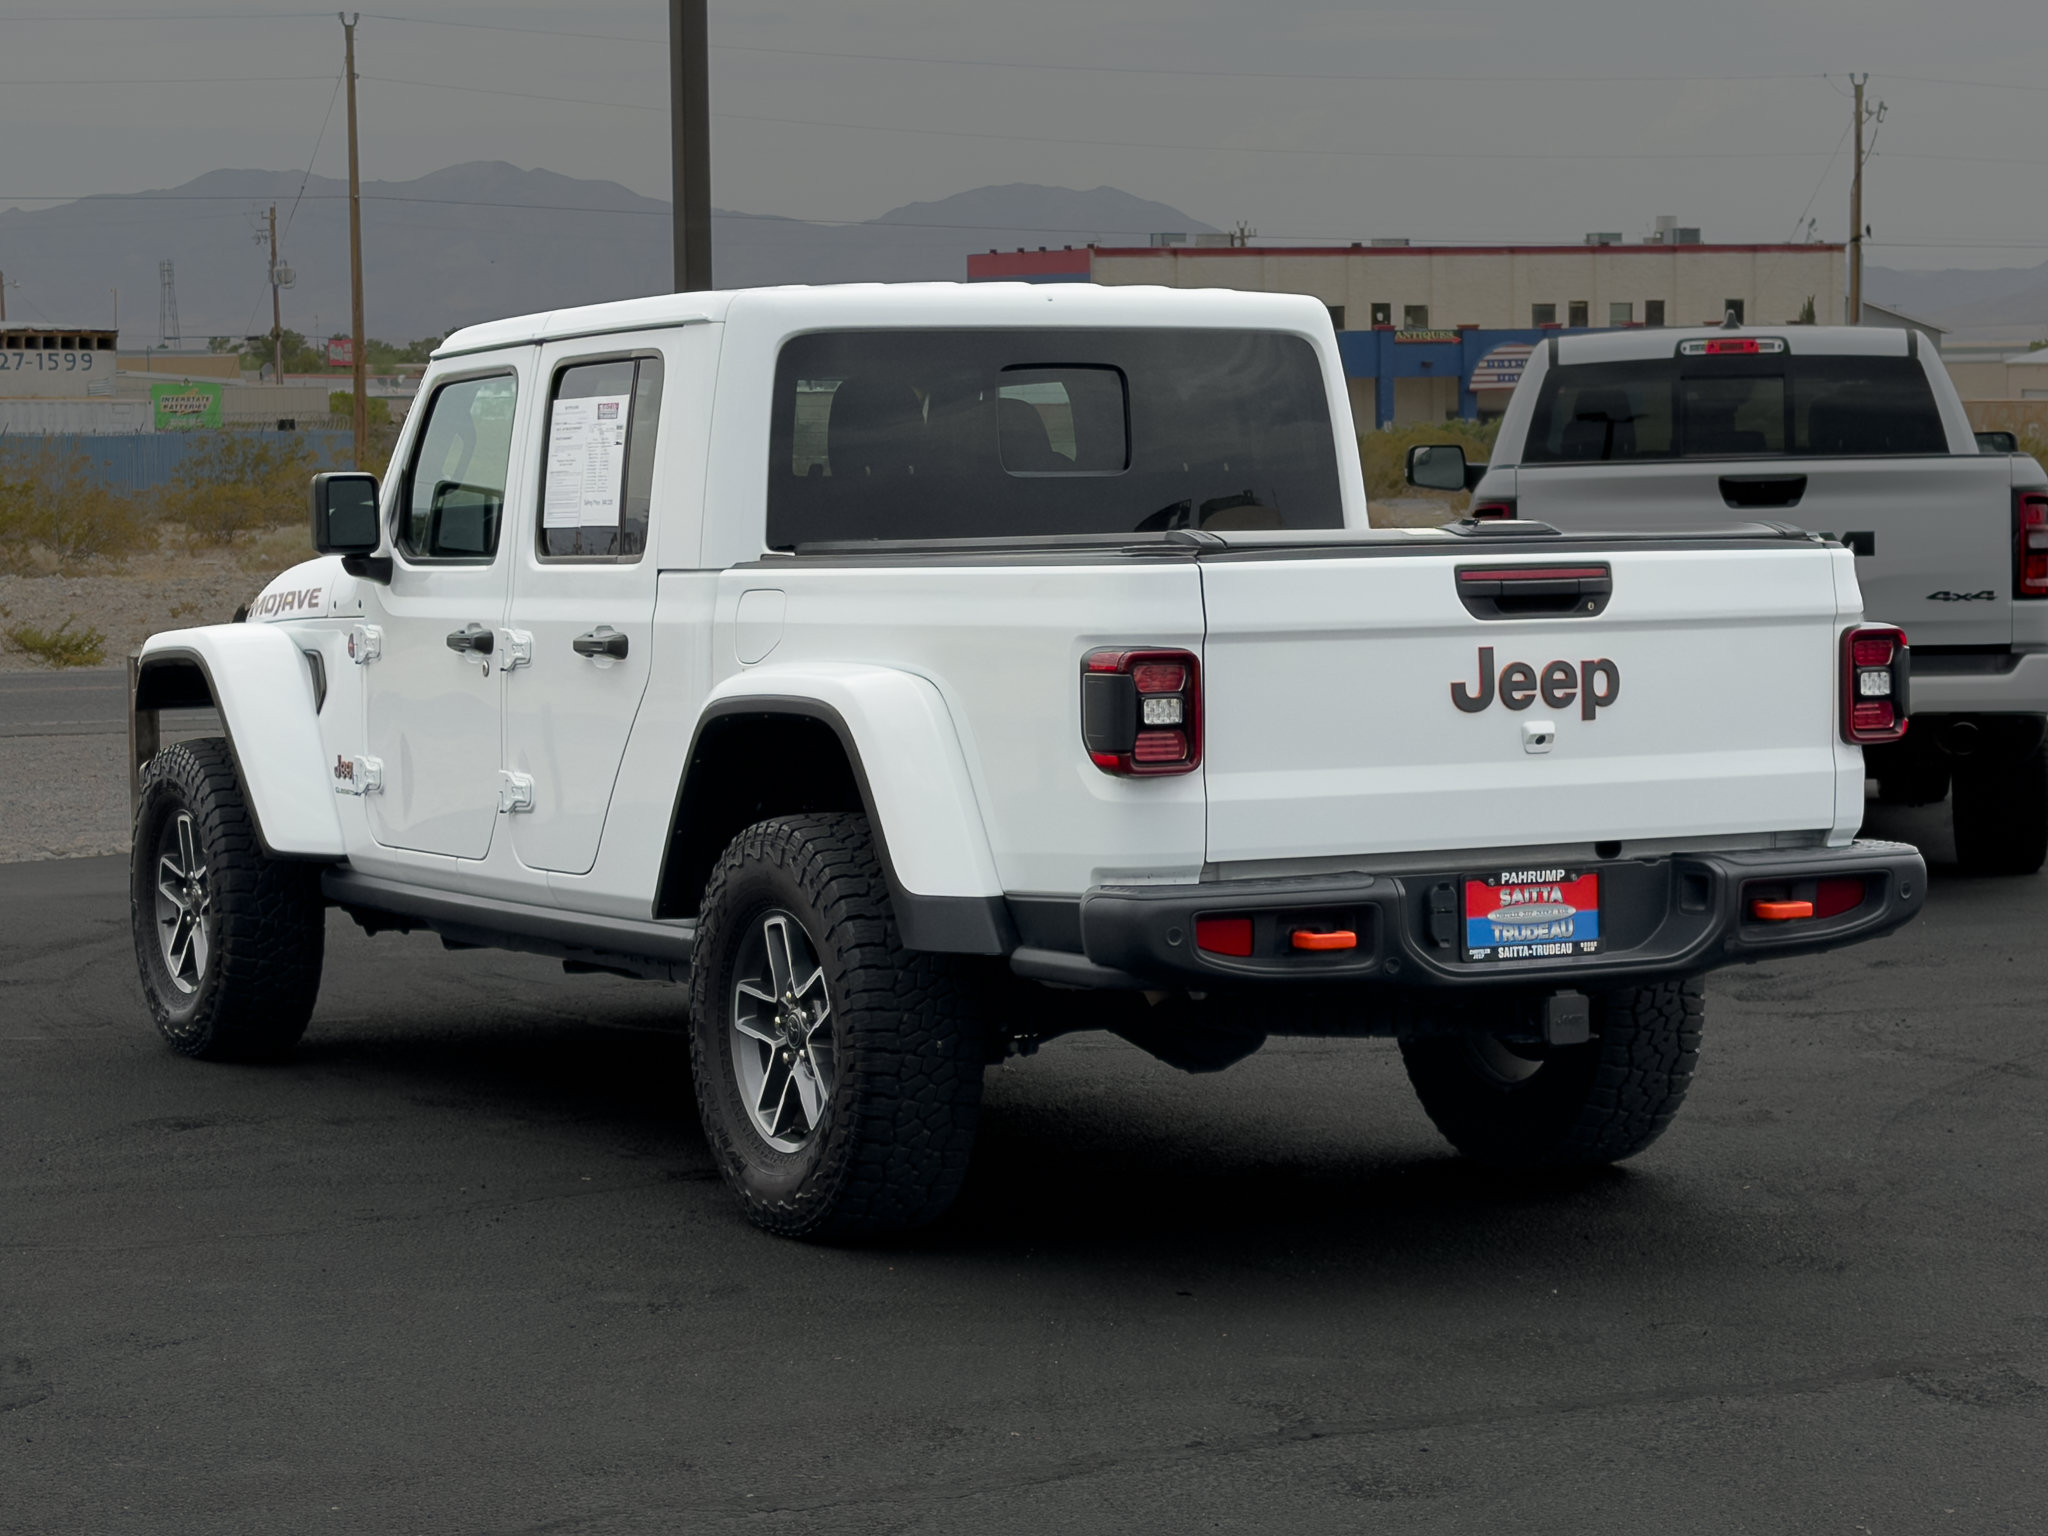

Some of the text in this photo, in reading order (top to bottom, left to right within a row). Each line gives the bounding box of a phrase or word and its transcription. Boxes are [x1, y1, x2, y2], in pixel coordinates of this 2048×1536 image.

[249, 587, 322, 617] MOJAVE
[1926, 590, 1997, 602] 4x4
[1450, 646, 1620, 721] Jeep
[334, 754, 354, 784] Jeep
[1501, 869, 1565, 885] PAHRUMP
[1499, 886, 1564, 907] SAITTA
[1491, 917, 1575, 943] TRUDEAU
[1498, 943, 1573, 959] SAITTA-TRUDEAU
